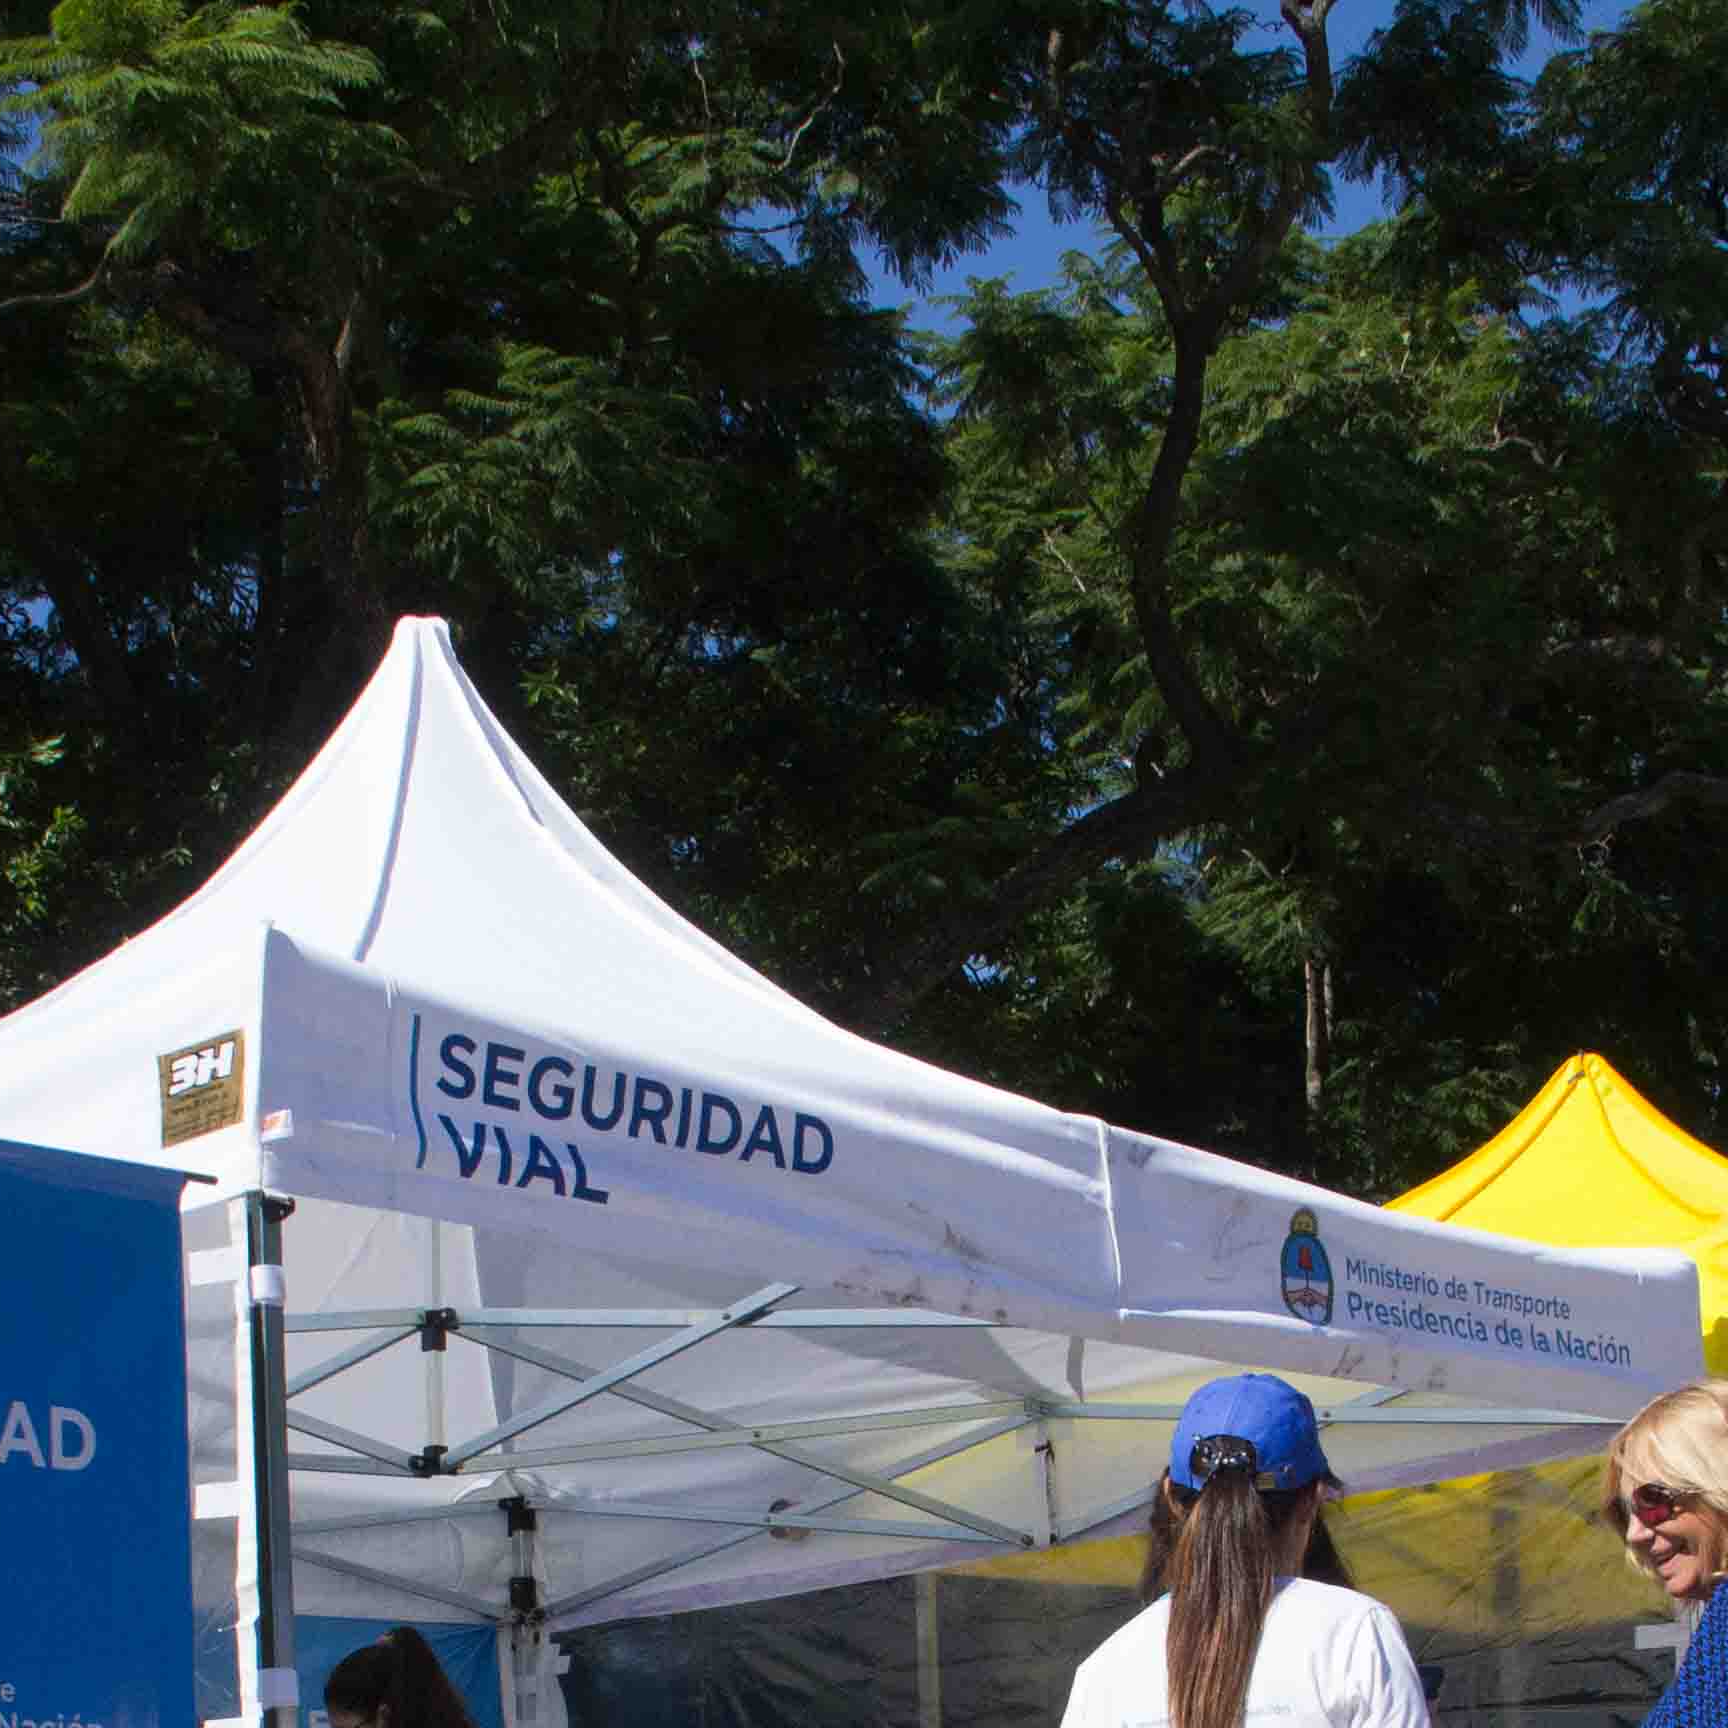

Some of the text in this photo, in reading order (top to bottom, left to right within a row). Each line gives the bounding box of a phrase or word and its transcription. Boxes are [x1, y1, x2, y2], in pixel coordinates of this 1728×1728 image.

[436, 1033, 835, 1175] SEGURIDAD
[438, 1112, 610, 1204] VIAL
[1345, 1256, 1571, 1320] Ministerio de Transporte
[1346, 1290, 1631, 1366] Presidencia de la Nación
